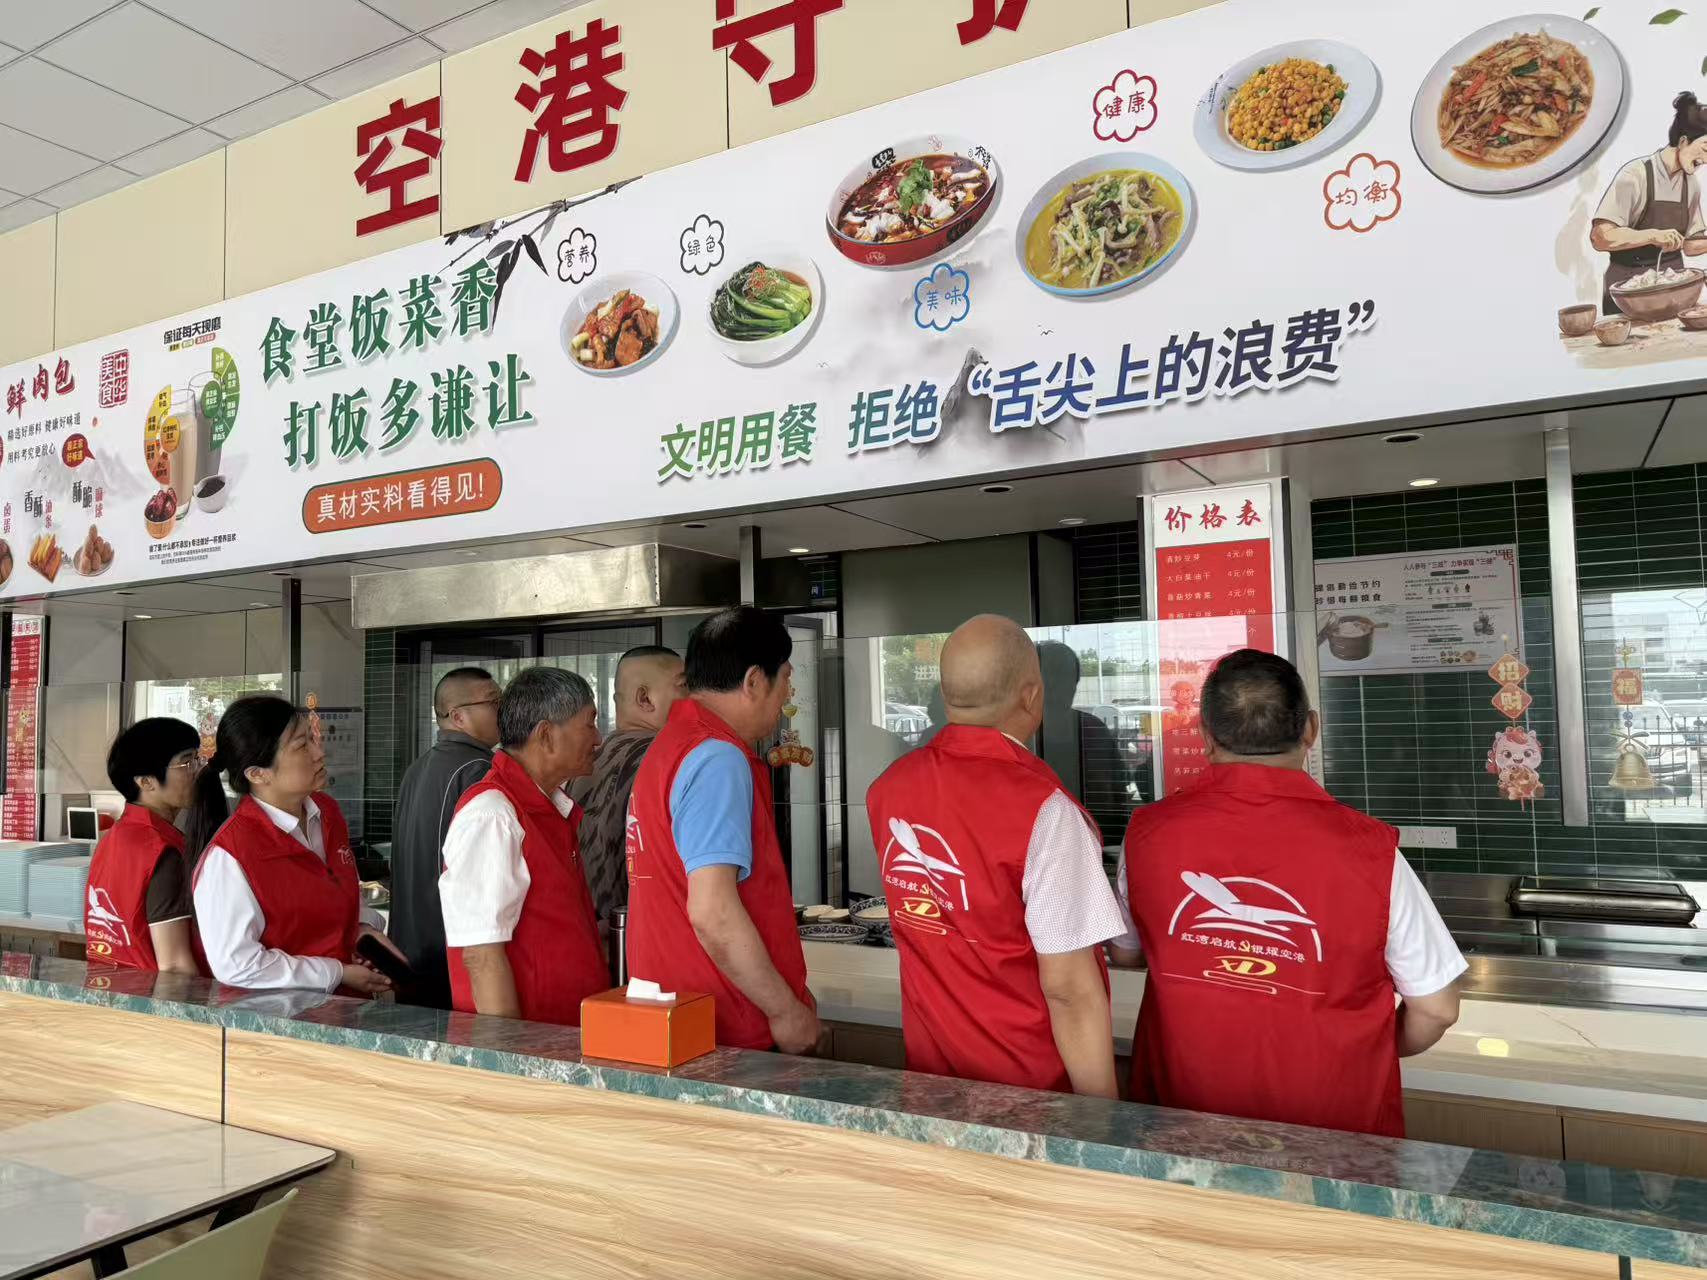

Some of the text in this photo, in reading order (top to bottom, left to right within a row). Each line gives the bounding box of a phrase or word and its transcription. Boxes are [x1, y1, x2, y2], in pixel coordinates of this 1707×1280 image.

[1102, 90, 1146, 119] 健康
[1335, 181, 1387, 208] 均衡
[564, 244, 589, 269] 营养
[687, 235, 715, 256] 绿色
[926, 287, 961, 308] 美味
[164, 316, 221, 344] 保证每天现磨
[259, 257, 498, 383] 食堂饭菜香
[6, 355, 76, 420] 鲜肉包
[283, 353, 533, 467] 打饭多谦让
[657, 402, 818, 478] 文明用餐
[1164, 499, 1262, 534] 价格表
